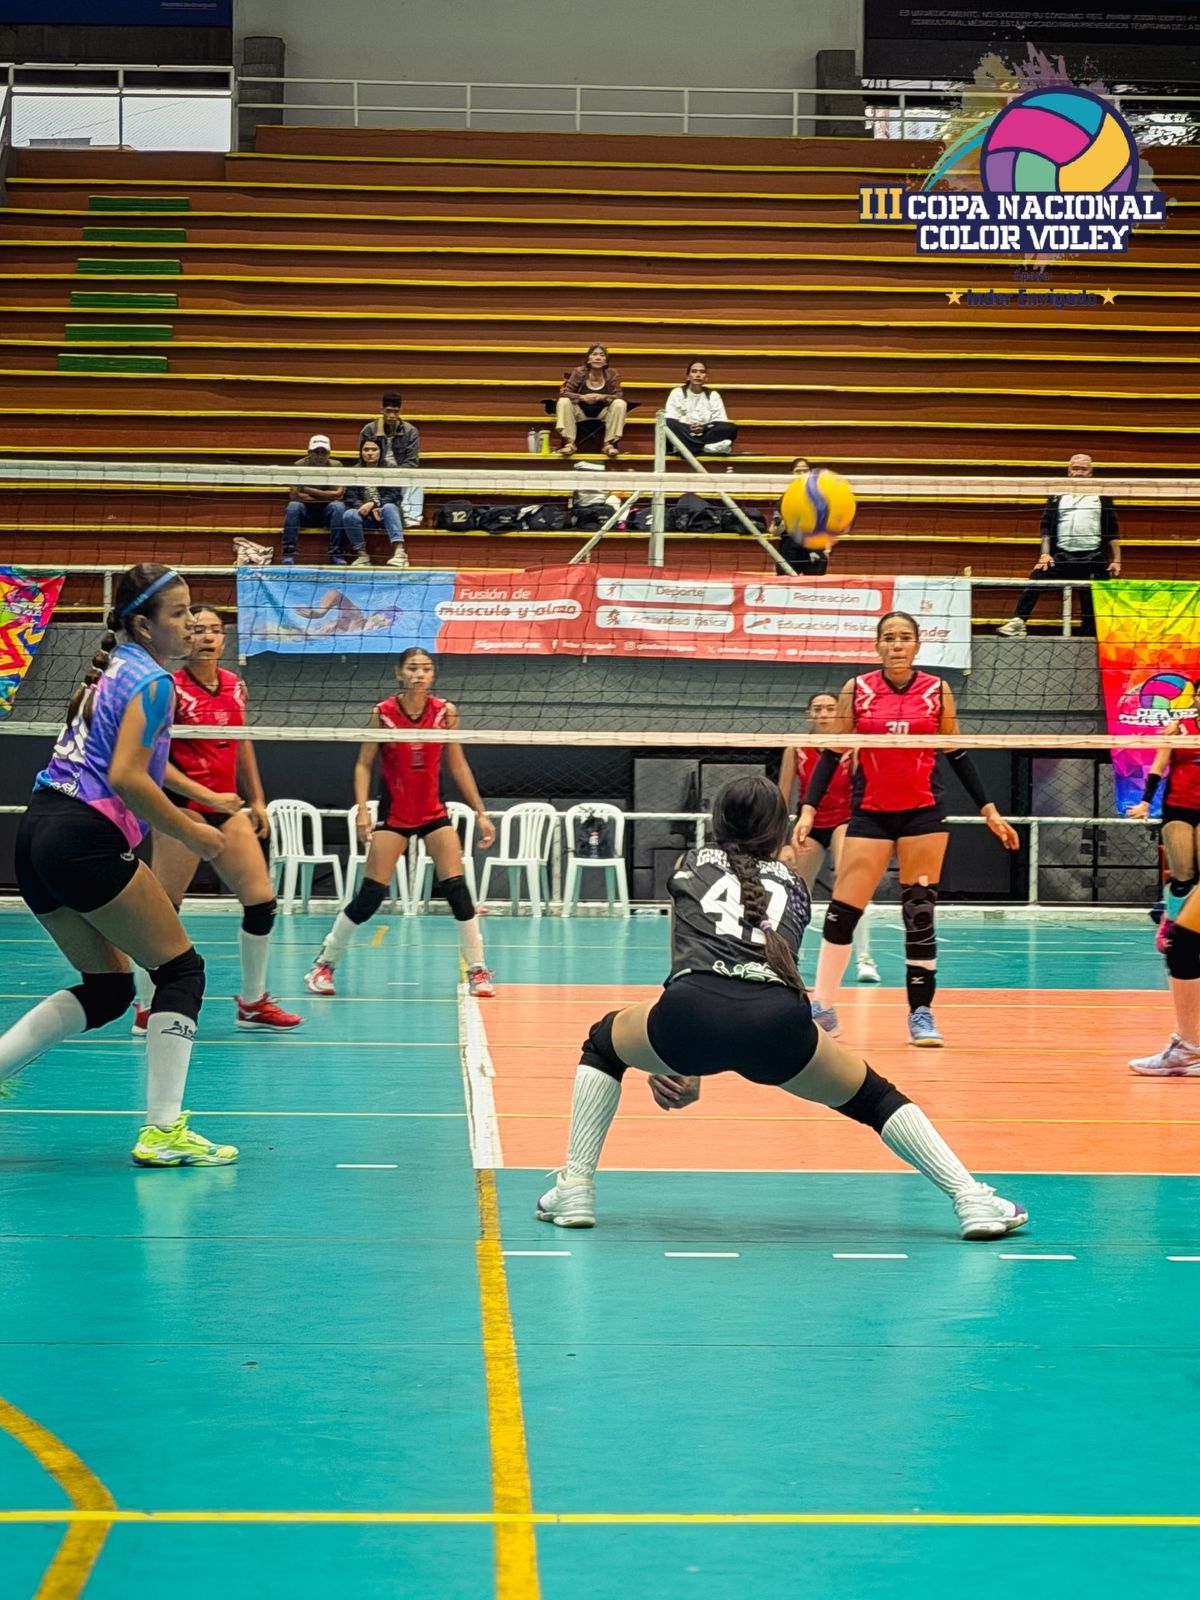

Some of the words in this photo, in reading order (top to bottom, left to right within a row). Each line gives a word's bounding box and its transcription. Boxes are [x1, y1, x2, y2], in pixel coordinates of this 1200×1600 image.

[460, 588, 508, 600] Fusión
[512, 588, 531, 600] de
[656, 586, 705, 599] Deporte
[793, 592, 860, 604] Recreación
[439, 604, 511, 617] músculo
[518, 606, 529, 618] y
[777, 620, 839, 631] Educación
[918, 623, 952, 638] nder
